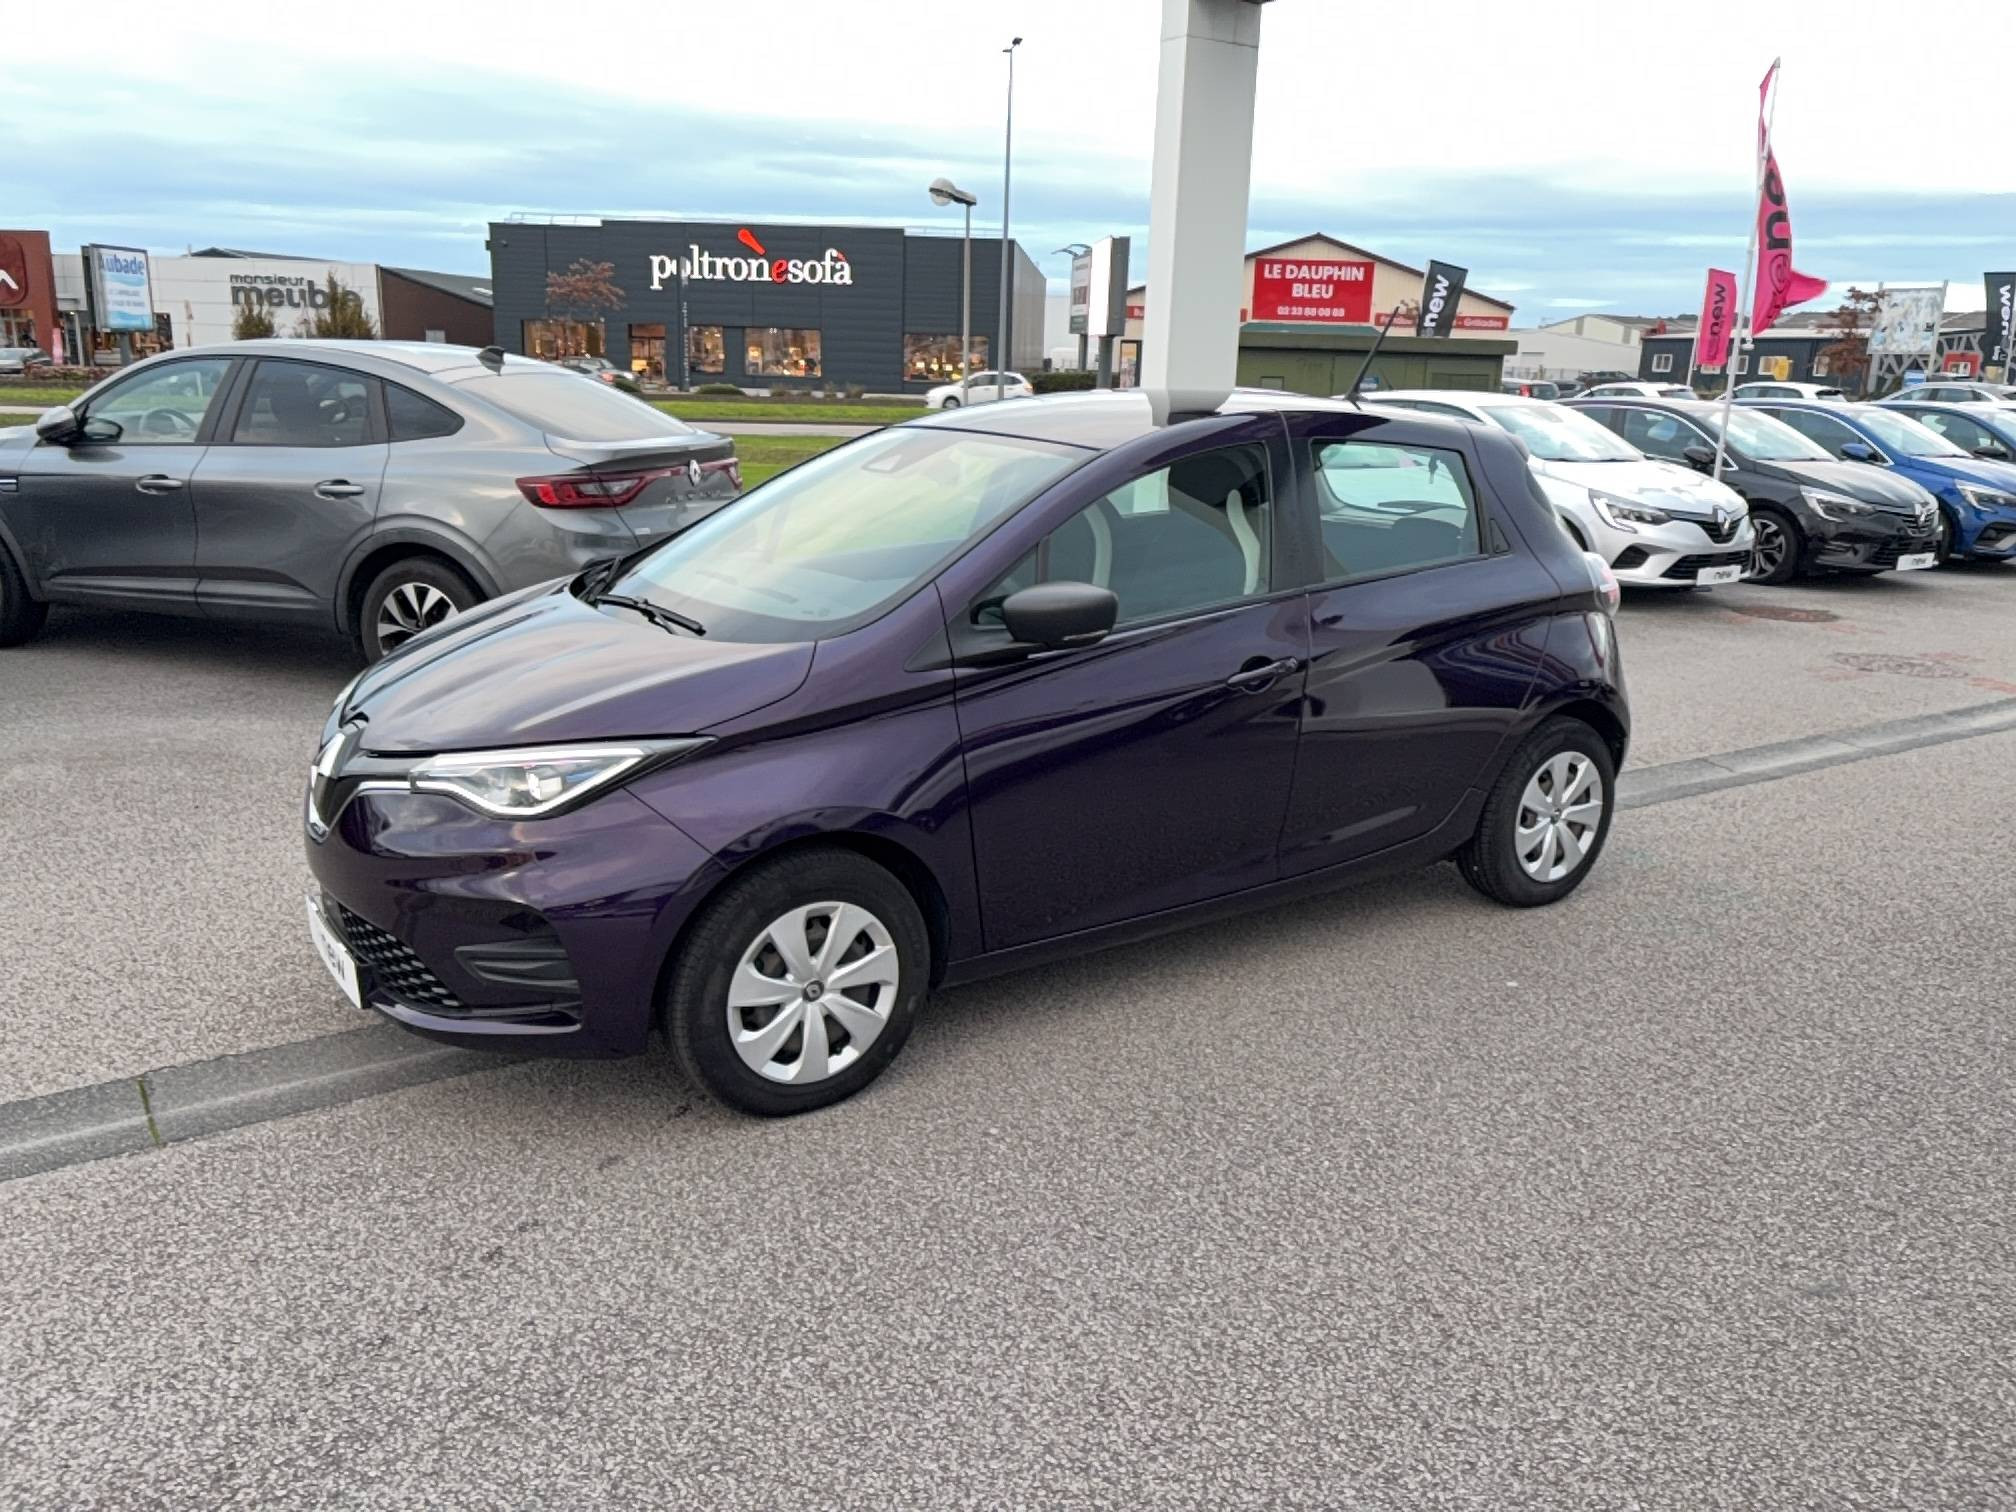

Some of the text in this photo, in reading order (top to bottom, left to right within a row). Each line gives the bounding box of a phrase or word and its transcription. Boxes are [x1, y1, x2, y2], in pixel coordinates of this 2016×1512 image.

[229, 274, 304, 286] monsieur
[1264, 264, 1365, 281] LE DAUPHIN
[231, 280, 364, 309] meube
[1291, 283, 1334, 299] BLEU
